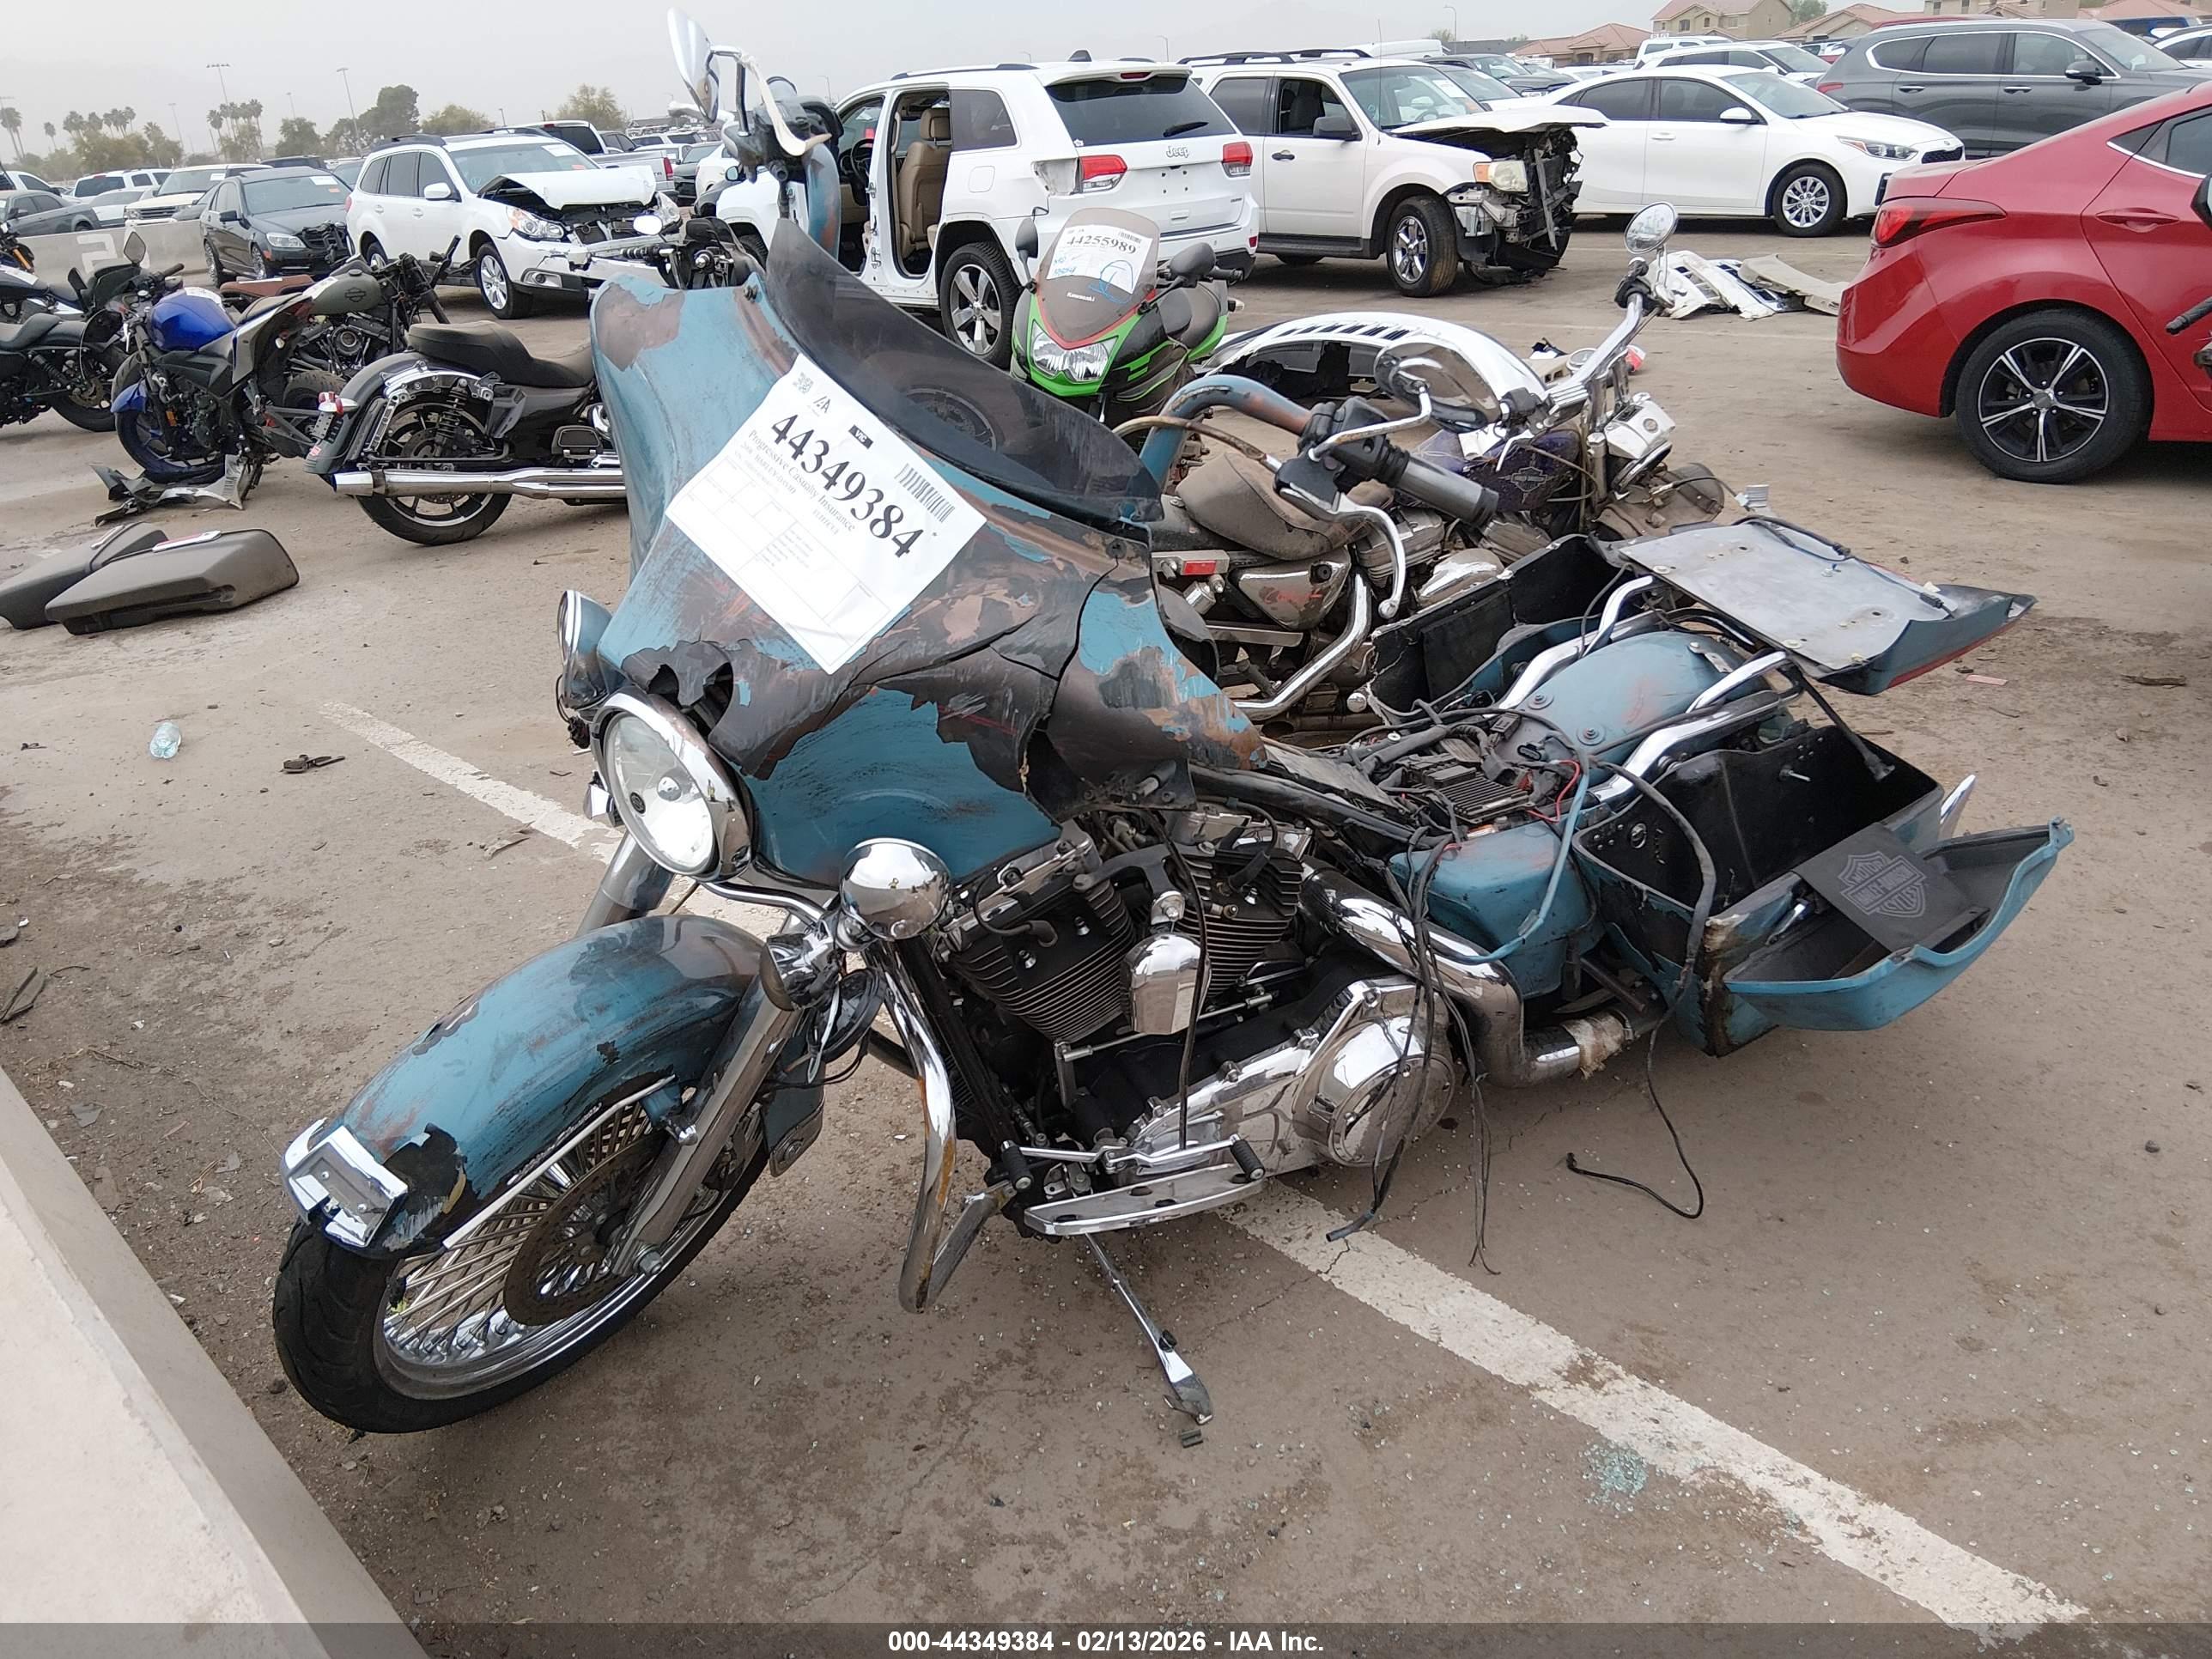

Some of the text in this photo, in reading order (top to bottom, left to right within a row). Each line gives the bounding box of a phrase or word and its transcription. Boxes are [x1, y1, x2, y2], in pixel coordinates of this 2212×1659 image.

[1166, 145, 1189, 158] Jeep
[1066, 235, 1137, 254] 44255989
[748, 428, 790, 471] Progressive
[788, 466, 817, 500] Casualty
[817, 493, 855, 532] Insurance
[772, 414, 924, 558] 44349384
[1853, 861, 1884, 884] MOTOR
